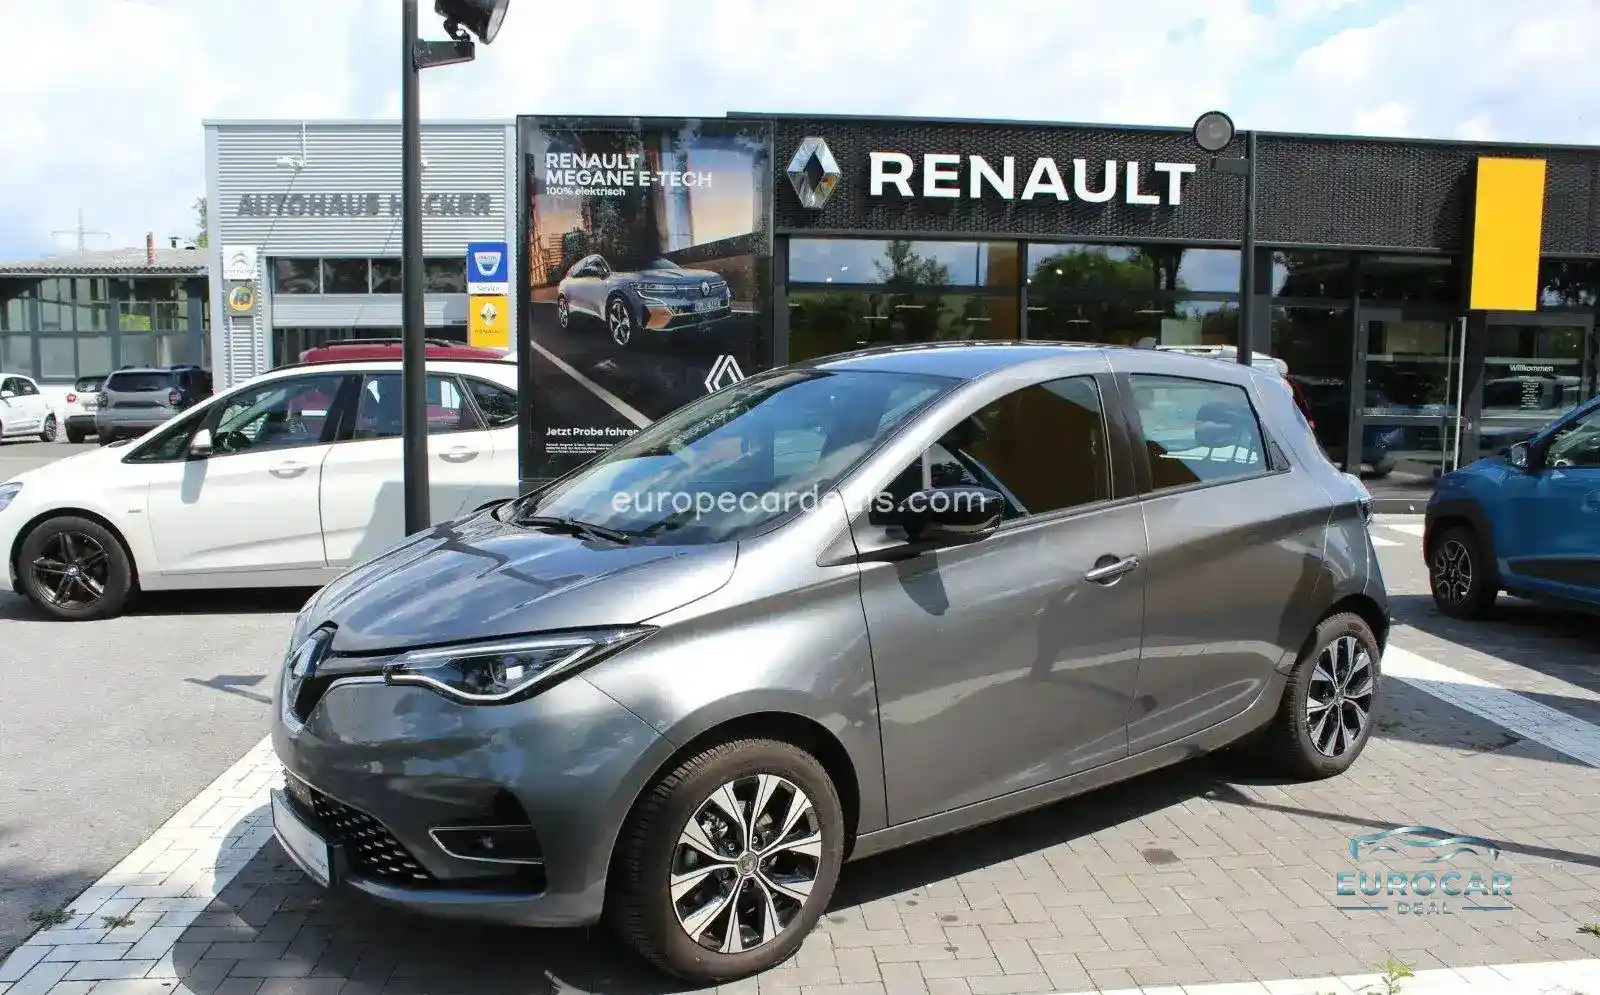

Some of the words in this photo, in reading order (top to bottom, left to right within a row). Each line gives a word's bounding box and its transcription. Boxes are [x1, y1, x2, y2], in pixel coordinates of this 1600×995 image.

[545, 152, 640, 169] RENAULT
[545, 170, 635, 187] MEGANE
[638, 171, 713, 188] E-TECH
[869, 151, 1197, 206] RENAULT
[545, 186, 574, 196] 100%
[575, 186, 626, 196] elektrisch
[237, 192, 380, 217] AUTOHAUS
[389, 192, 492, 217] HCKER
[1509, 364, 1554, 372] Willkommen
[545, 427, 572, 436] Jetzt
[572, 427, 604, 436] Probe
